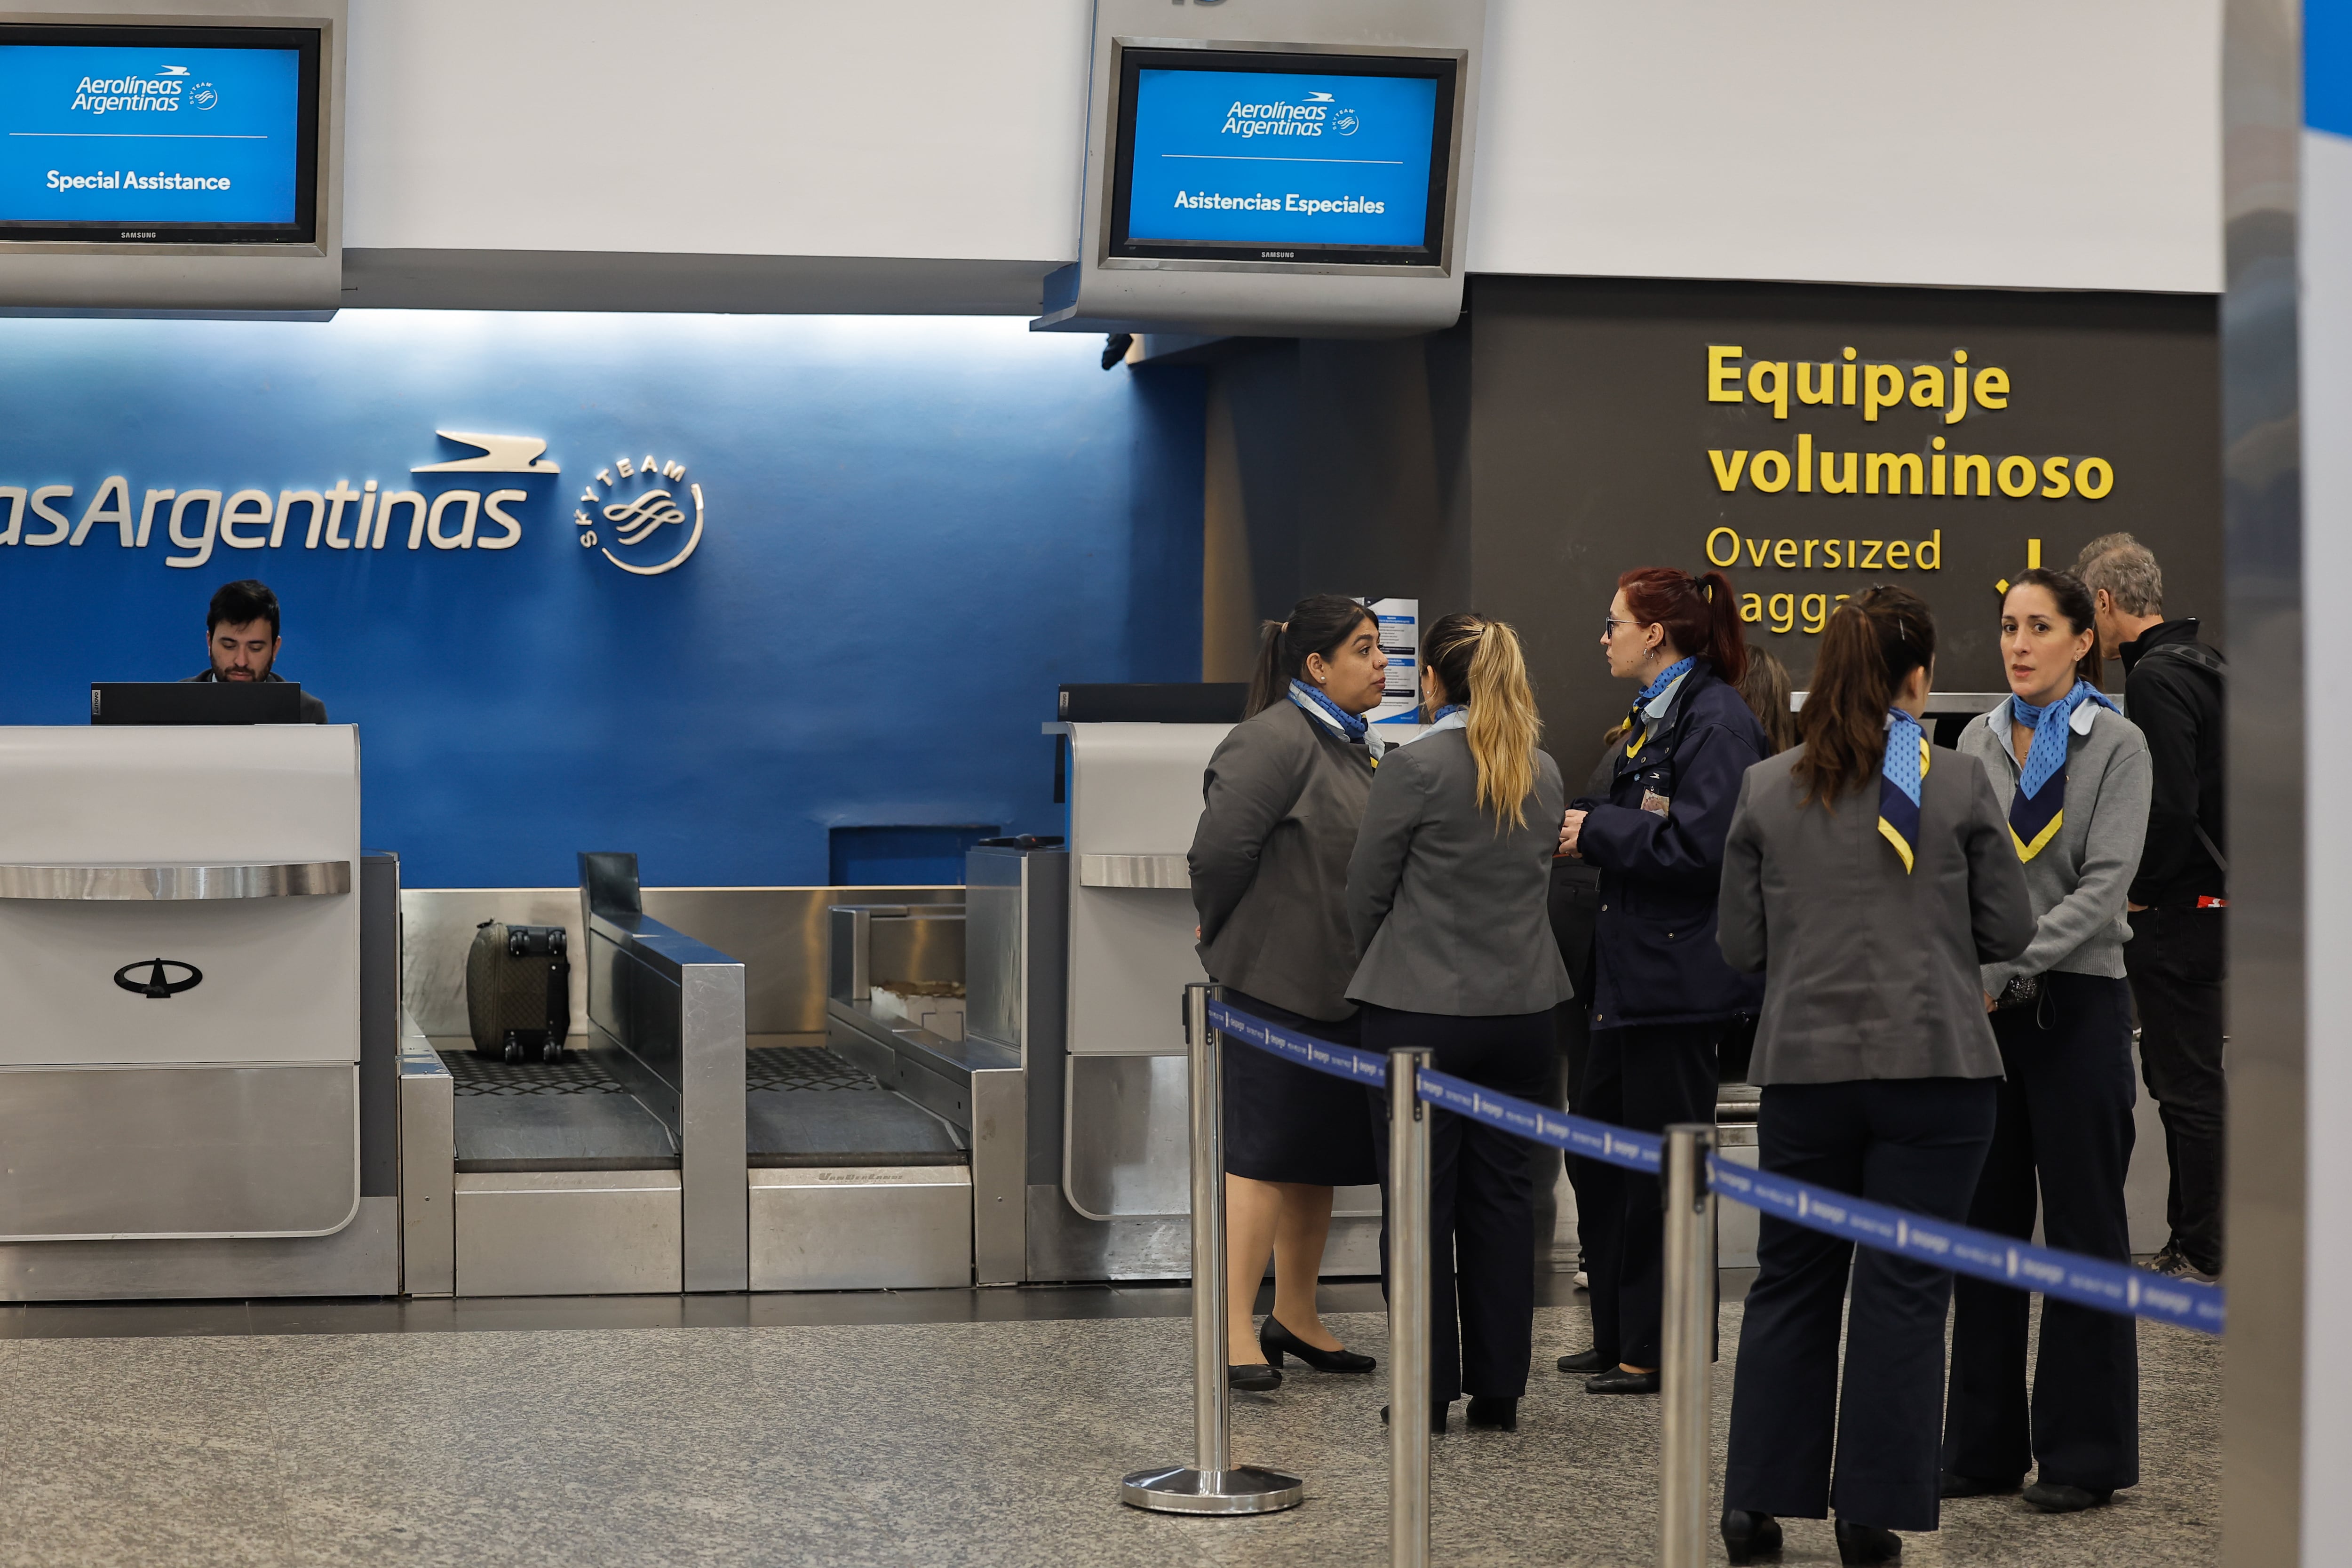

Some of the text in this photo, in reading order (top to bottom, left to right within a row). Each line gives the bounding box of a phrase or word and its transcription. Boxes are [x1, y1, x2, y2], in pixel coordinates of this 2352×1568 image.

[76, 75, 182, 95] Aerolíneas
[189, 82, 212, 104] SKYTEAM
[72, 94, 180, 114] Argentinas
[1227, 101, 1327, 121] Aerolíneas
[1221, 118, 1323, 138] Argentinas
[46, 170, 231, 192] Special Assistance
[1174, 191, 1385, 216] Asistencias Especiales
[1708, 345, 2010, 424] Equipaje
[1708, 433, 2114, 500] voluminoso
[573, 455, 686, 548] SKYTEAM
